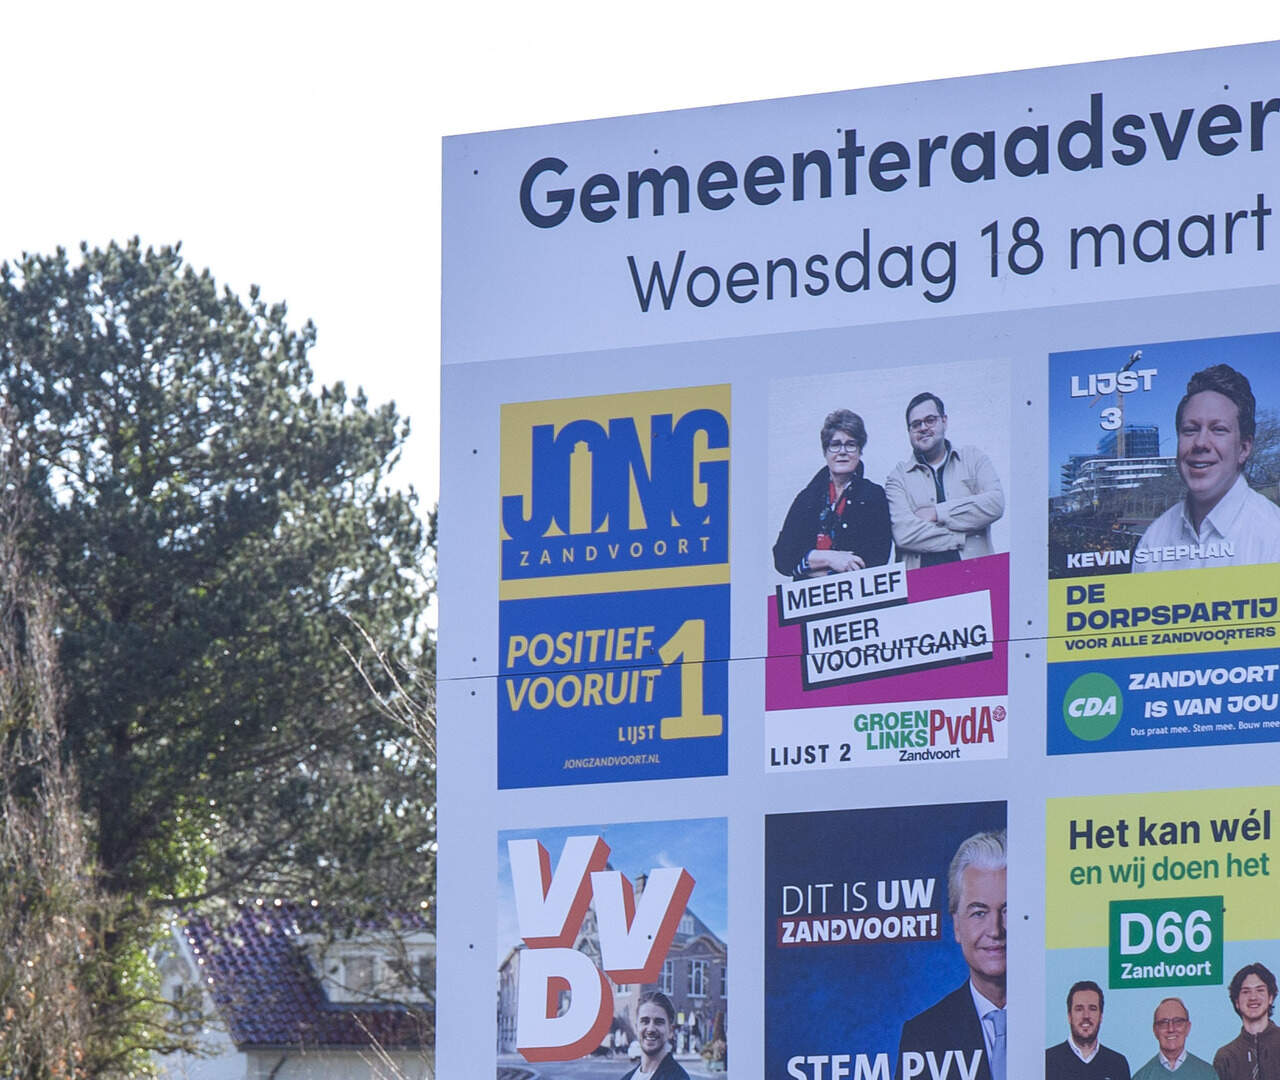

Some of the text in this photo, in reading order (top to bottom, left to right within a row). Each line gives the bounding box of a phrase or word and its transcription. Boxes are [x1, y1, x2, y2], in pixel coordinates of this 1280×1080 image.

[627, 228, 957, 313] Woensdag
[981, 215, 1043, 277] 18
[1070, 193, 1272, 270] maart
[1070, 368, 1157, 398] LIJST
[1099, 407, 1122, 430] 3
[502, 408, 729, 540] JONG
[520, 537, 710, 566] ZANDVOORT
[1066, 542, 1235, 568] KEVIN STEPHAN
[787, 570, 901, 611] MEER LEF
[1066, 583, 1105, 605] DE
[1066, 597, 1278, 631] DORPSPARTIJ
[506, 626, 655, 668] POSITIEF
[813, 617, 879, 648] MEER
[1065, 626, 1276, 651] VOOR ALLE ZANDVOORTERS
[812, 624, 987, 674] VOORUITGANG
[506, 669, 662, 711] VOORUIT
[618, 619, 723, 744] LIJST 1
[1128, 664, 1279, 690] ZANDVOORT
[853, 710, 928, 732] GROEN
[1068, 695, 1117, 718] CDA
[1144, 694, 1279, 718] IS VAN JOU
[929, 706, 994, 746] PvdA
[1130, 727, 1145, 736] Dus
[1147, 727, 1168, 737] praat
[1193, 723, 1213, 732] Stem
[1238, 721, 1260, 729] Bouw
[563, 754, 660, 769] JONGZANDVOORT.NL
[770, 743, 851, 766] LIJST 2
[899, 748, 960, 761] Zandvoort
[1070, 808, 1271, 850] Het kan wél
[1070, 852, 1270, 889] en wij doen het
[782, 878, 936, 915] DIT IS UW
[781, 913, 938, 943] ZANDVOORT!
[1119, 909, 1212, 955] D66
[507, 835, 697, 1063] VVD
[1120, 960, 1211, 980] Zandvoort
